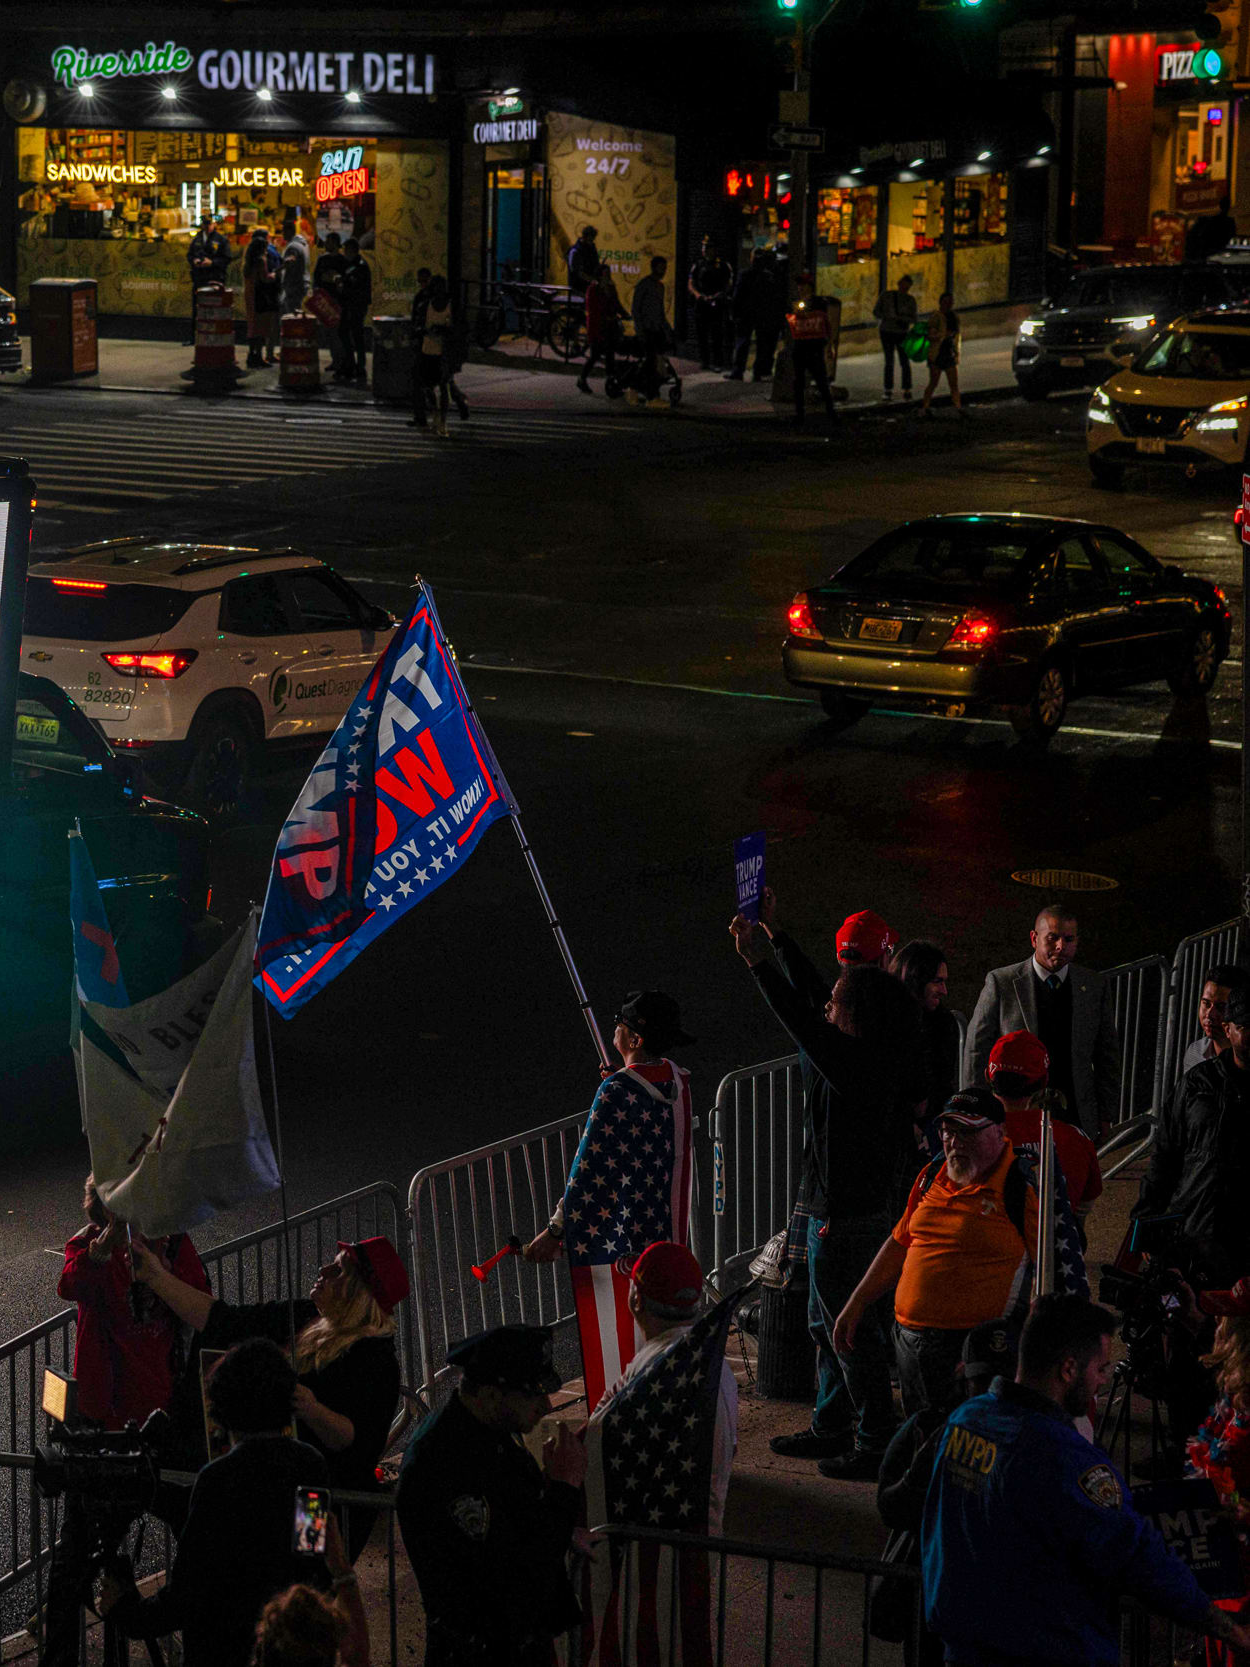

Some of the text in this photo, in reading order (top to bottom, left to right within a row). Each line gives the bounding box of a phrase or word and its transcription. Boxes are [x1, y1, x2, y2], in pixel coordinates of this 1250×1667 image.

[53, 40, 434, 94] Riverside GOURMET DELI
[1161, 50, 1198, 80] PIZZ
[576, 138, 643, 152] Welcome
[47, 163, 157, 184] SANDWICHES
[320, 146, 363, 177] 24/7
[585, 157, 630, 175] 24/7
[213, 167, 304, 187] JUICE BAR
[316, 168, 368, 202] OPEN
[88, 672, 101, 686] 62
[295, 680, 327, 700] Quest
[84, 690, 131, 705] 82820
[736, 856, 763, 884] TRUMP
[738, 878, 758, 902] VANCE
[715, 1146, 724, 1212] NYPD
[945, 1425, 997, 1474] NYPD
